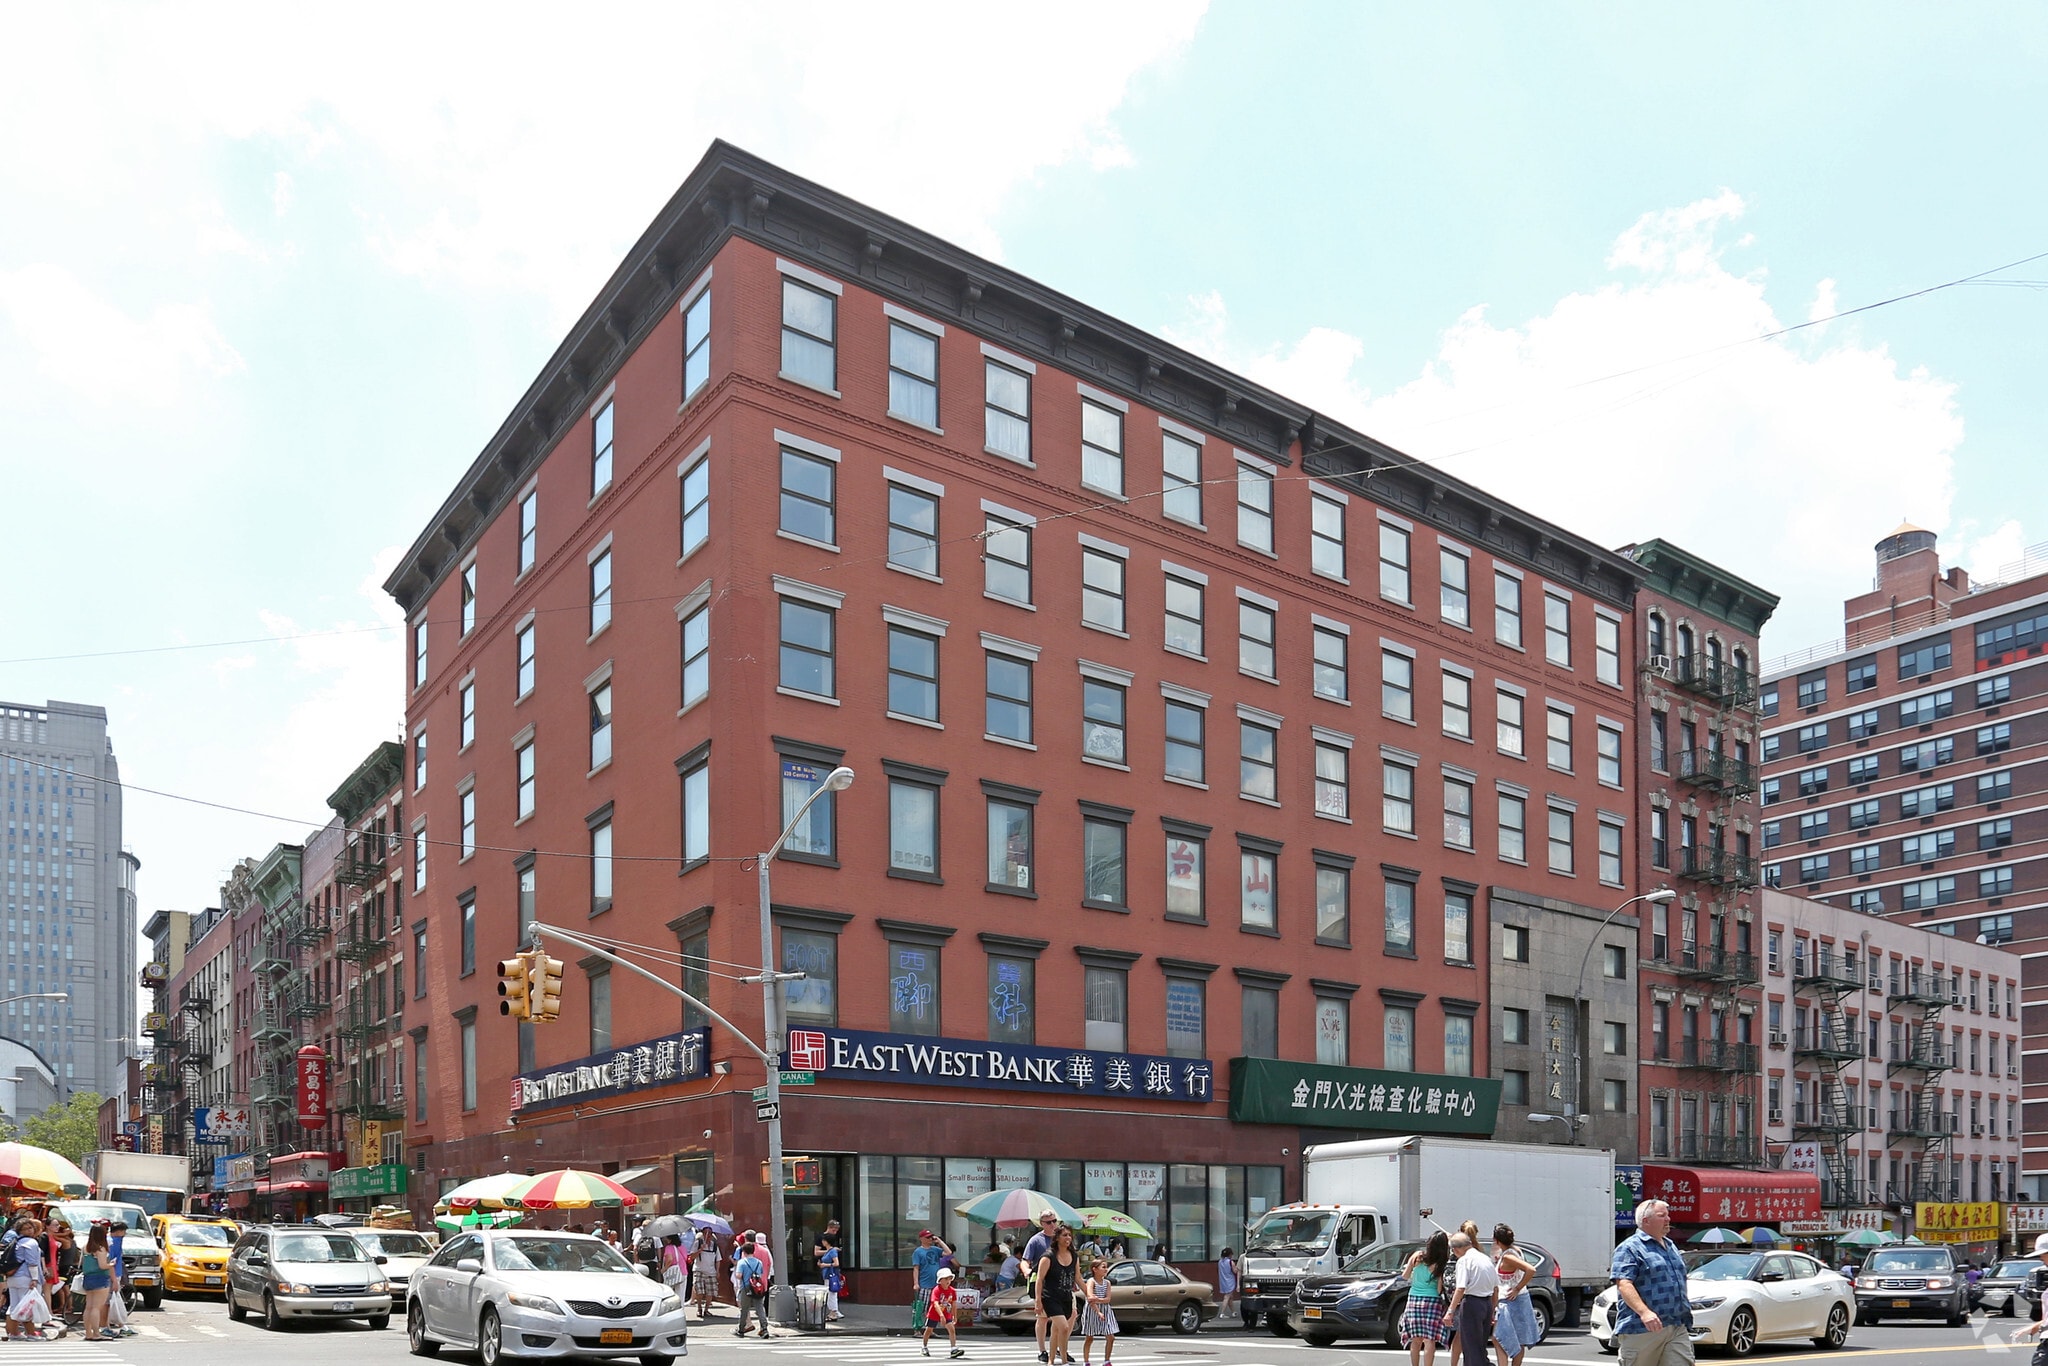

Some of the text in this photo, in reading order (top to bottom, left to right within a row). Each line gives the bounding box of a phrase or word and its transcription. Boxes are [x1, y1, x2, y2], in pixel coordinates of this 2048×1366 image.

[1171, 842, 1269, 893] 台 山
[786, 943, 828, 972] FOOT
[611, 1033, 703, 1089] 華美銀行
[1066, 1054, 1210, 1097] 華美銀行
[304, 1060, 321, 1114] 兆昌肉食
[1291, 1078, 1476, 1117] 金門X光檢查化驗中心
[215, 1109, 250, 1124] 永利
[1718, 1197, 1748, 1220] 雄記
